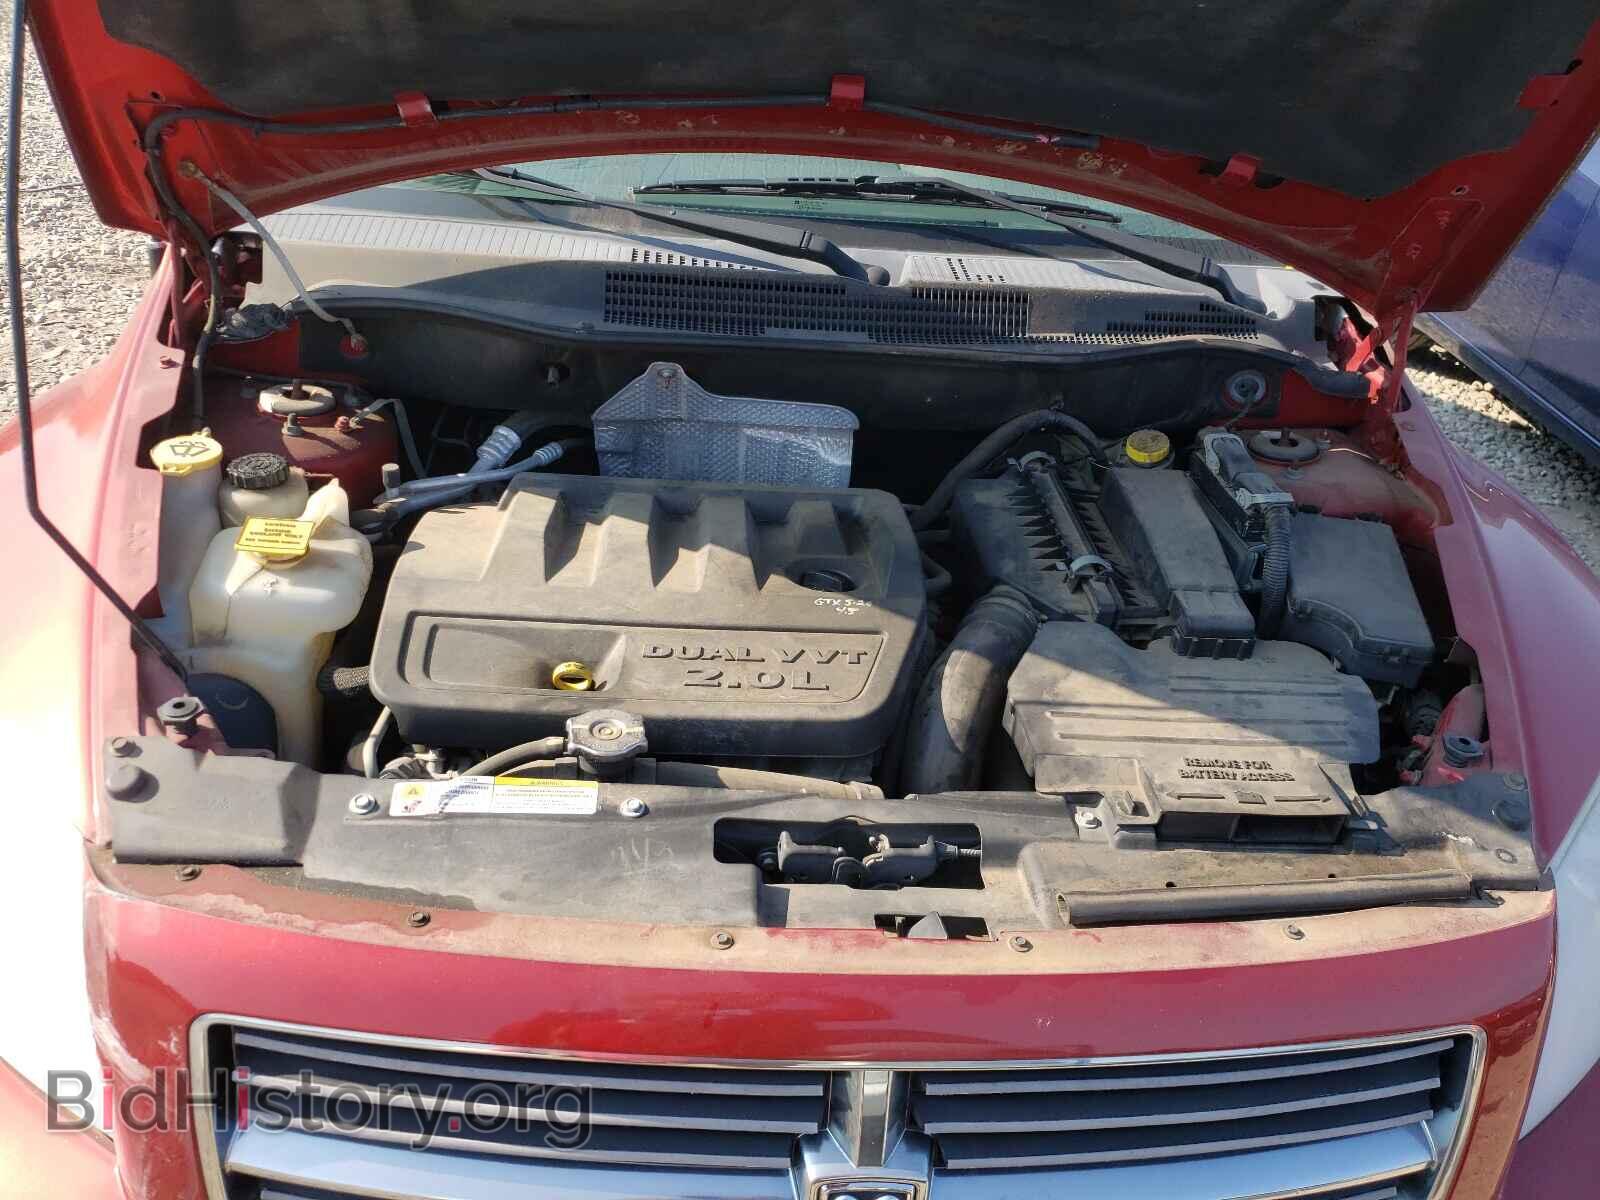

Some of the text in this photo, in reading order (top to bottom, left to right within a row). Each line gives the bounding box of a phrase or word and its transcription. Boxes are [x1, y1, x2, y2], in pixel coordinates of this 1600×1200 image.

[642, 643, 869, 665] DUAL VVT
[683, 669, 830, 691] 2.0L
[1183, 758, 1274, 771] REMOVE FOR
[1179, 769, 1296, 782] BATTERY ACCESS
